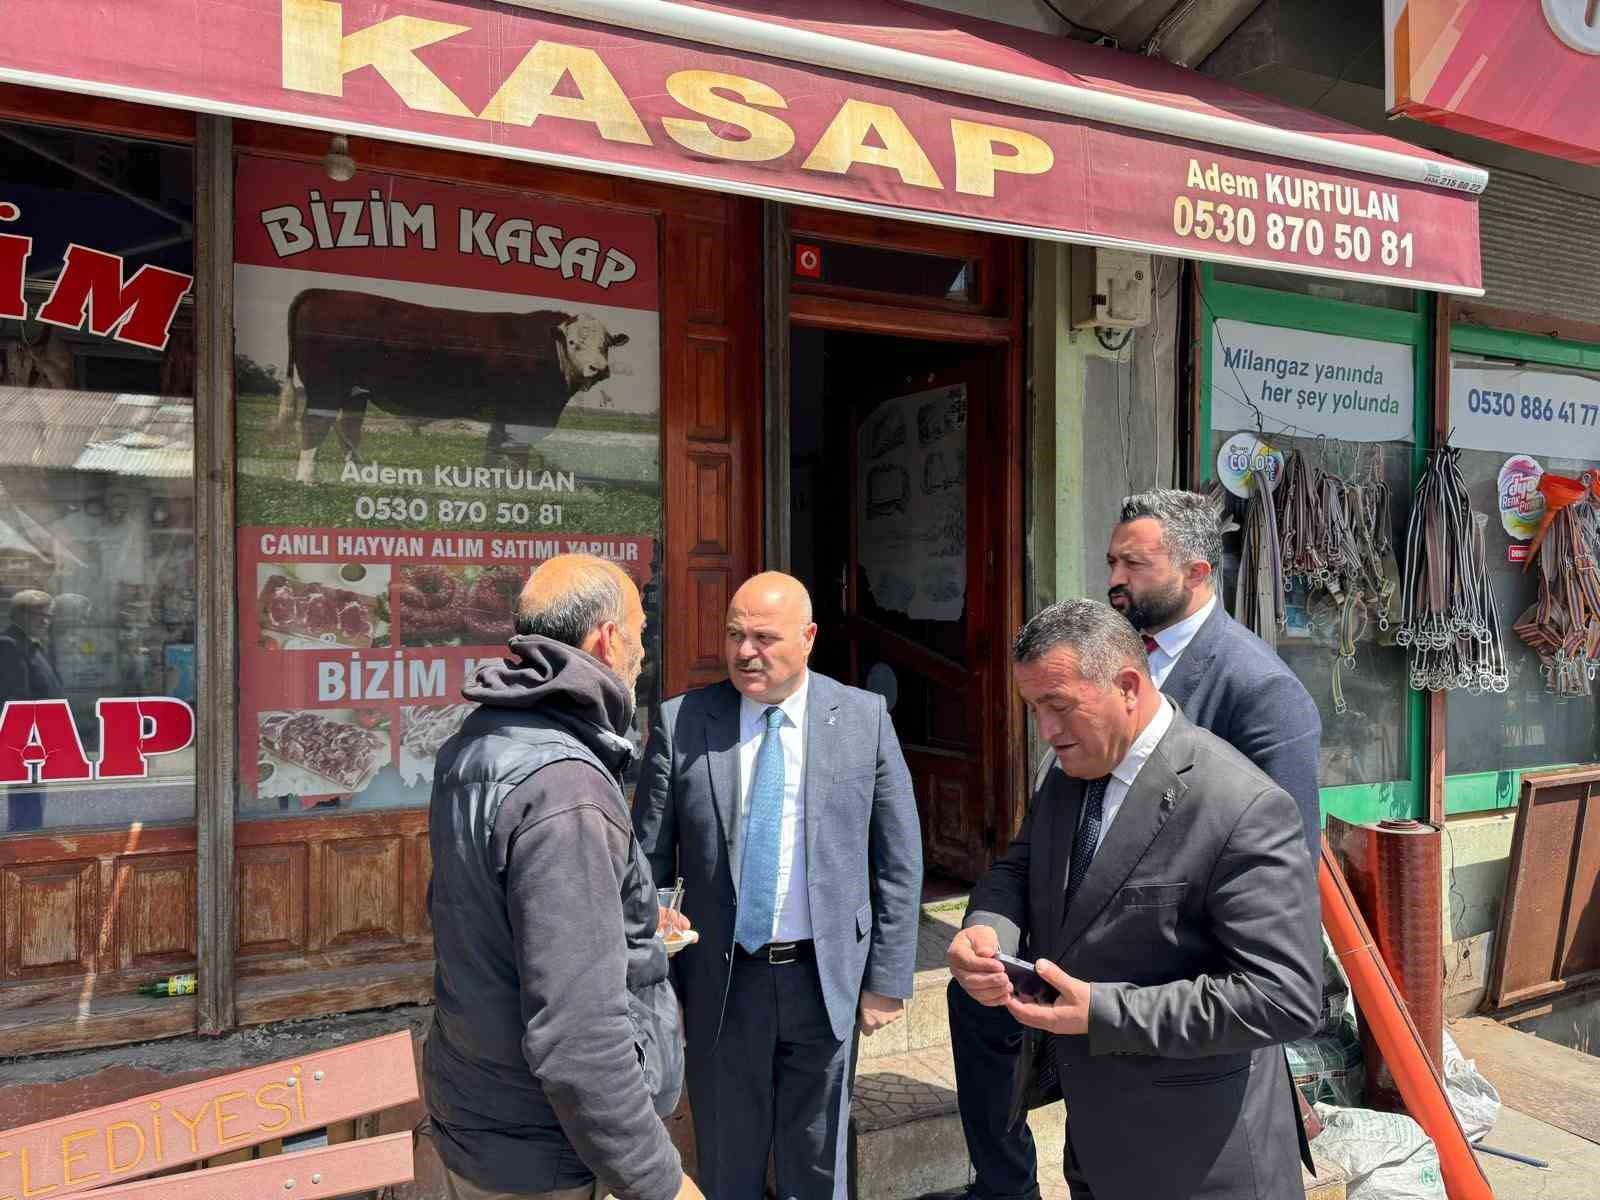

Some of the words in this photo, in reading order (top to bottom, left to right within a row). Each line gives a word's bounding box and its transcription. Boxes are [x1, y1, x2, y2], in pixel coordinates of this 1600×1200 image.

[281, 0, 1055, 198] KASAP
[1187, 159, 1258, 200] Adem
[1264, 172, 1399, 223] KURTULAN
[260, 189, 438, 258] BİZİM
[456, 206, 637, 290] KASAP
[1173, 195, 1256, 246] 0530
[1266, 213, 1325, 256] 870
[1334, 224, 1371, 262] 50
[1380, 230, 1414, 268] 81
[1223, 347, 1310, 379] Milangaz
[1315, 363, 1384, 385] yanında
[1261, 380, 1292, 402] her
[1296, 388, 1328, 413] şey
[1332, 390, 1400, 414] yolunda
[1468, 388, 1516, 417] 0530
[1520, 395, 1554, 421] 886
[1558, 400, 1576, 424] 41
[1580, 404, 1599, 426] 77
[341, 461, 423, 486] Adem
[435, 465, 575, 492] KURTULAN
[355, 496, 428, 521] 0530
[438, 500, 487, 523] 870
[496, 503, 529, 524] 50
[539, 505, 563, 525] 81
[260, 534, 329, 556] CANLI
[337, 536, 424, 557] HAYVAN
[431, 538, 484, 558] ALIM
[491, 539, 560, 559] SATIMI
[566, 541, 638, 560] YAPILIR
[318, 651, 446, 702] BİZİM
[0, 1065, 306, 1200] LEDİYESİ
